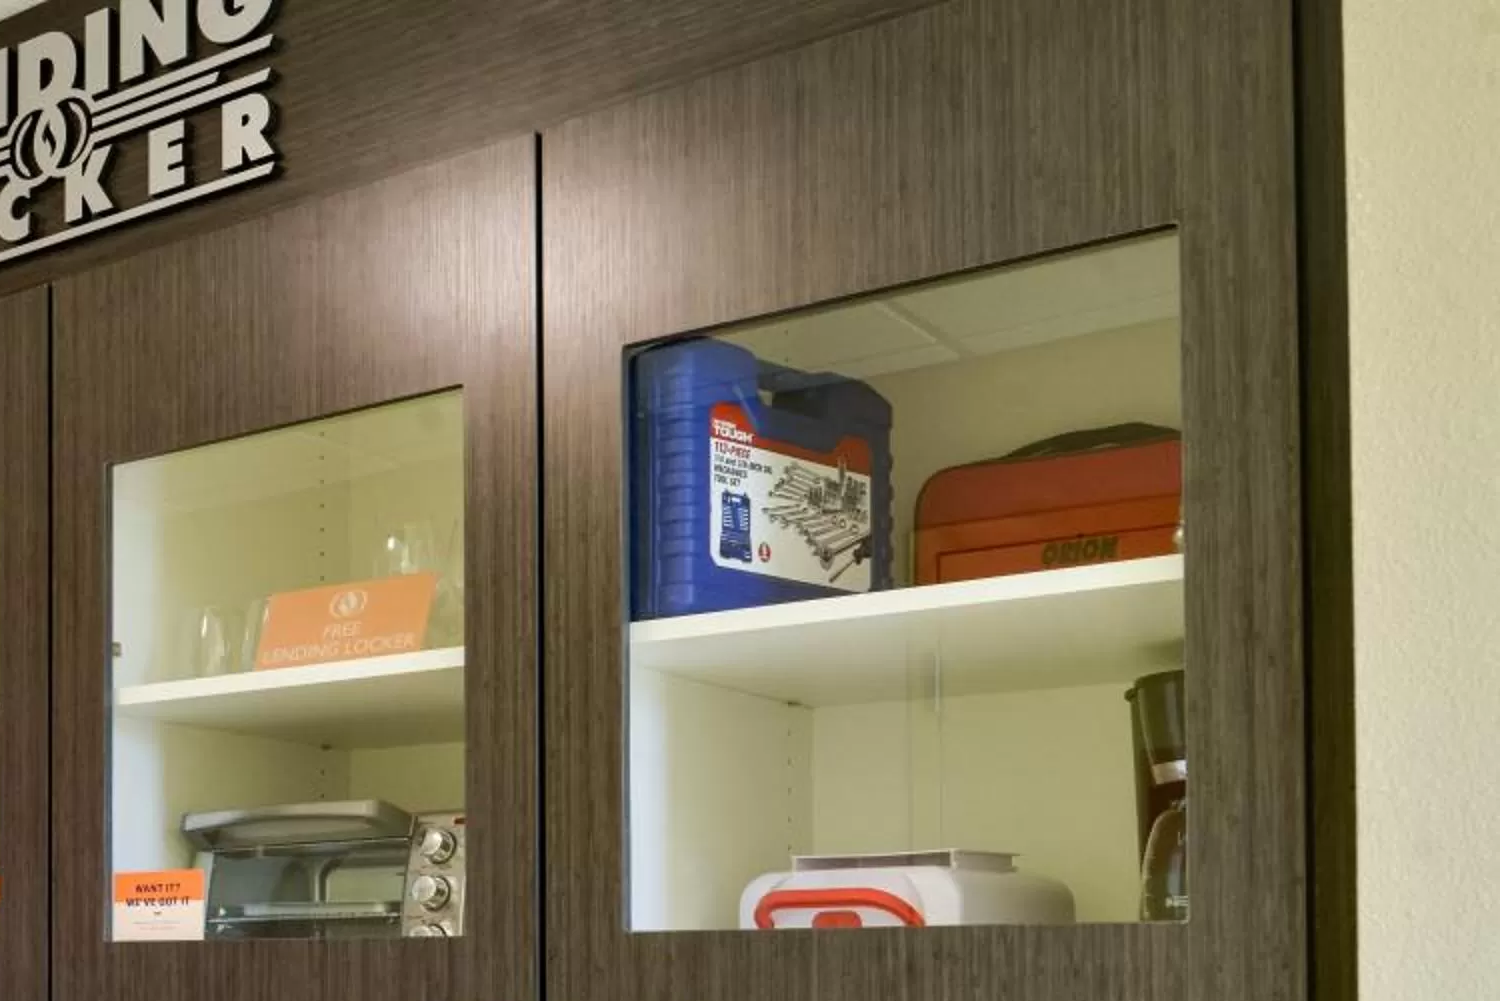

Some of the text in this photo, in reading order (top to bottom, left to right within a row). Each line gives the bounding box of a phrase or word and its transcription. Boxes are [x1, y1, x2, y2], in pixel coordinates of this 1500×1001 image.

[712, 424, 756, 444] TOUGH
[1042, 535, 1120, 566] ORION
[322, 620, 362, 641] FREE
[263, 631, 417, 663] LENDING LOCKER
